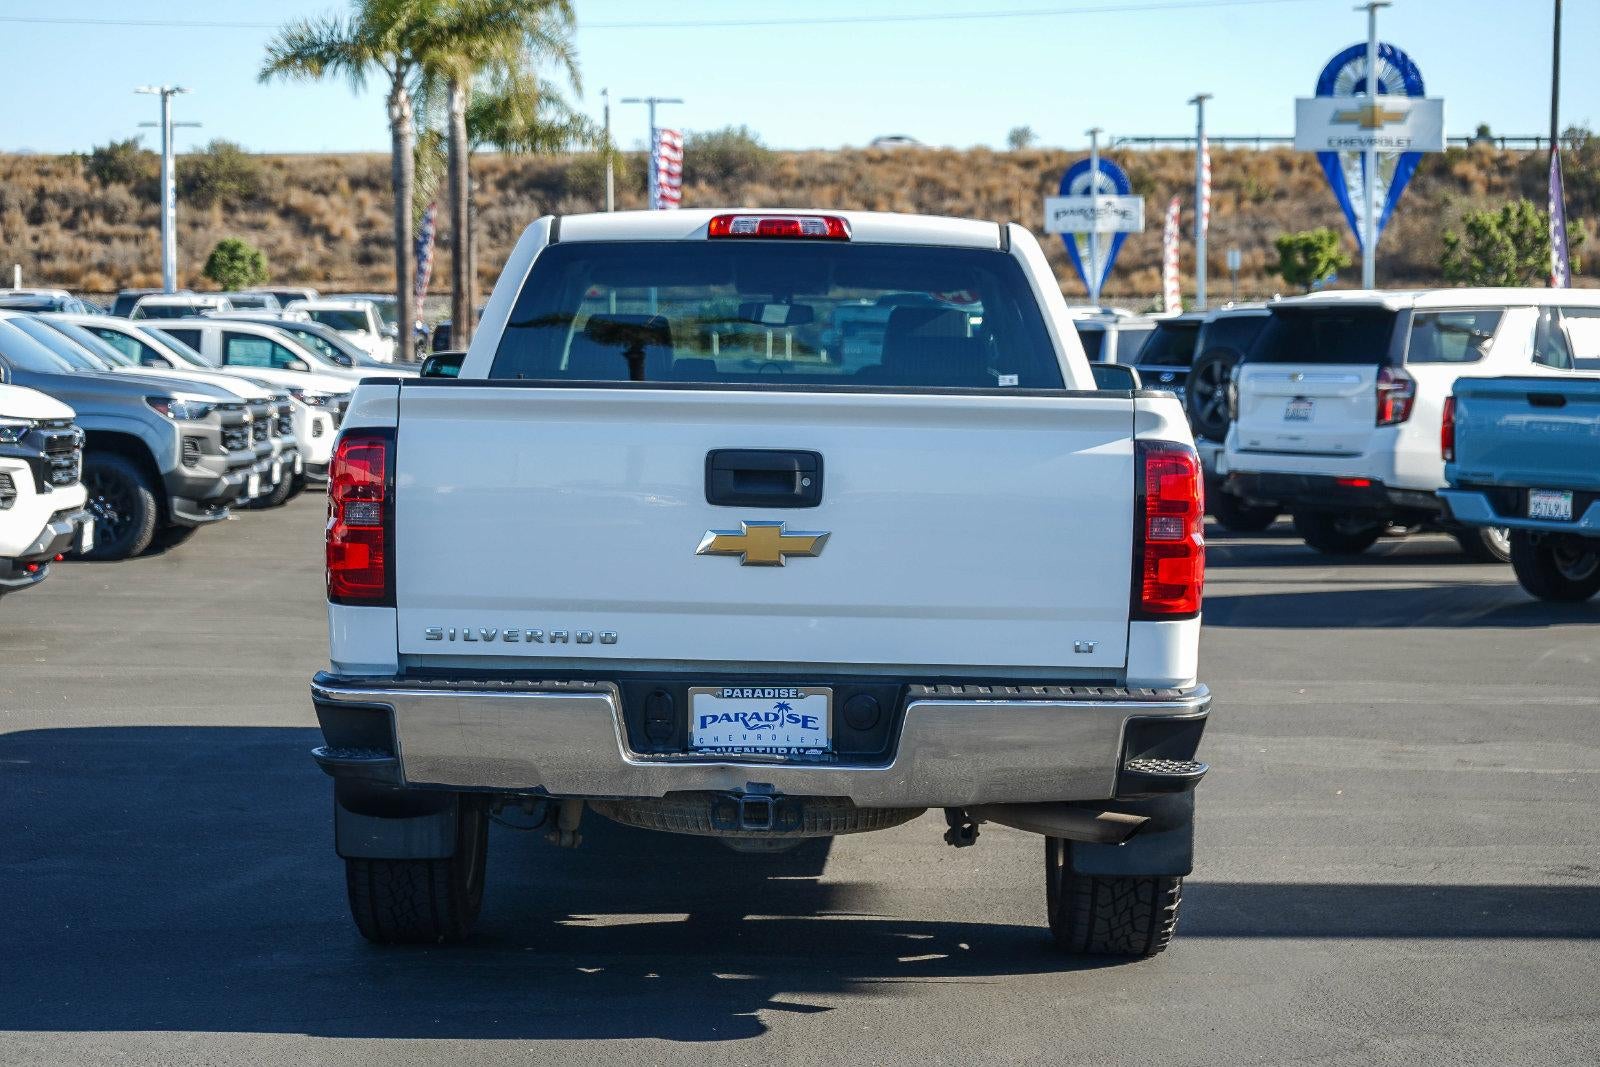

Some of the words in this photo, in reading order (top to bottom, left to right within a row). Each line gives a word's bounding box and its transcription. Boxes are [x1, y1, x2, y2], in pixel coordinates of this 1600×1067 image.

[1328, 137, 1412, 148] CHEVROLET
[425, 626, 618, 645] SILVERADO
[1074, 639, 1098, 653] LT
[723, 688, 797, 698] PARADISE
[699, 702, 820, 730] PARADISE
[699, 734, 820, 745] CHEVROLET
